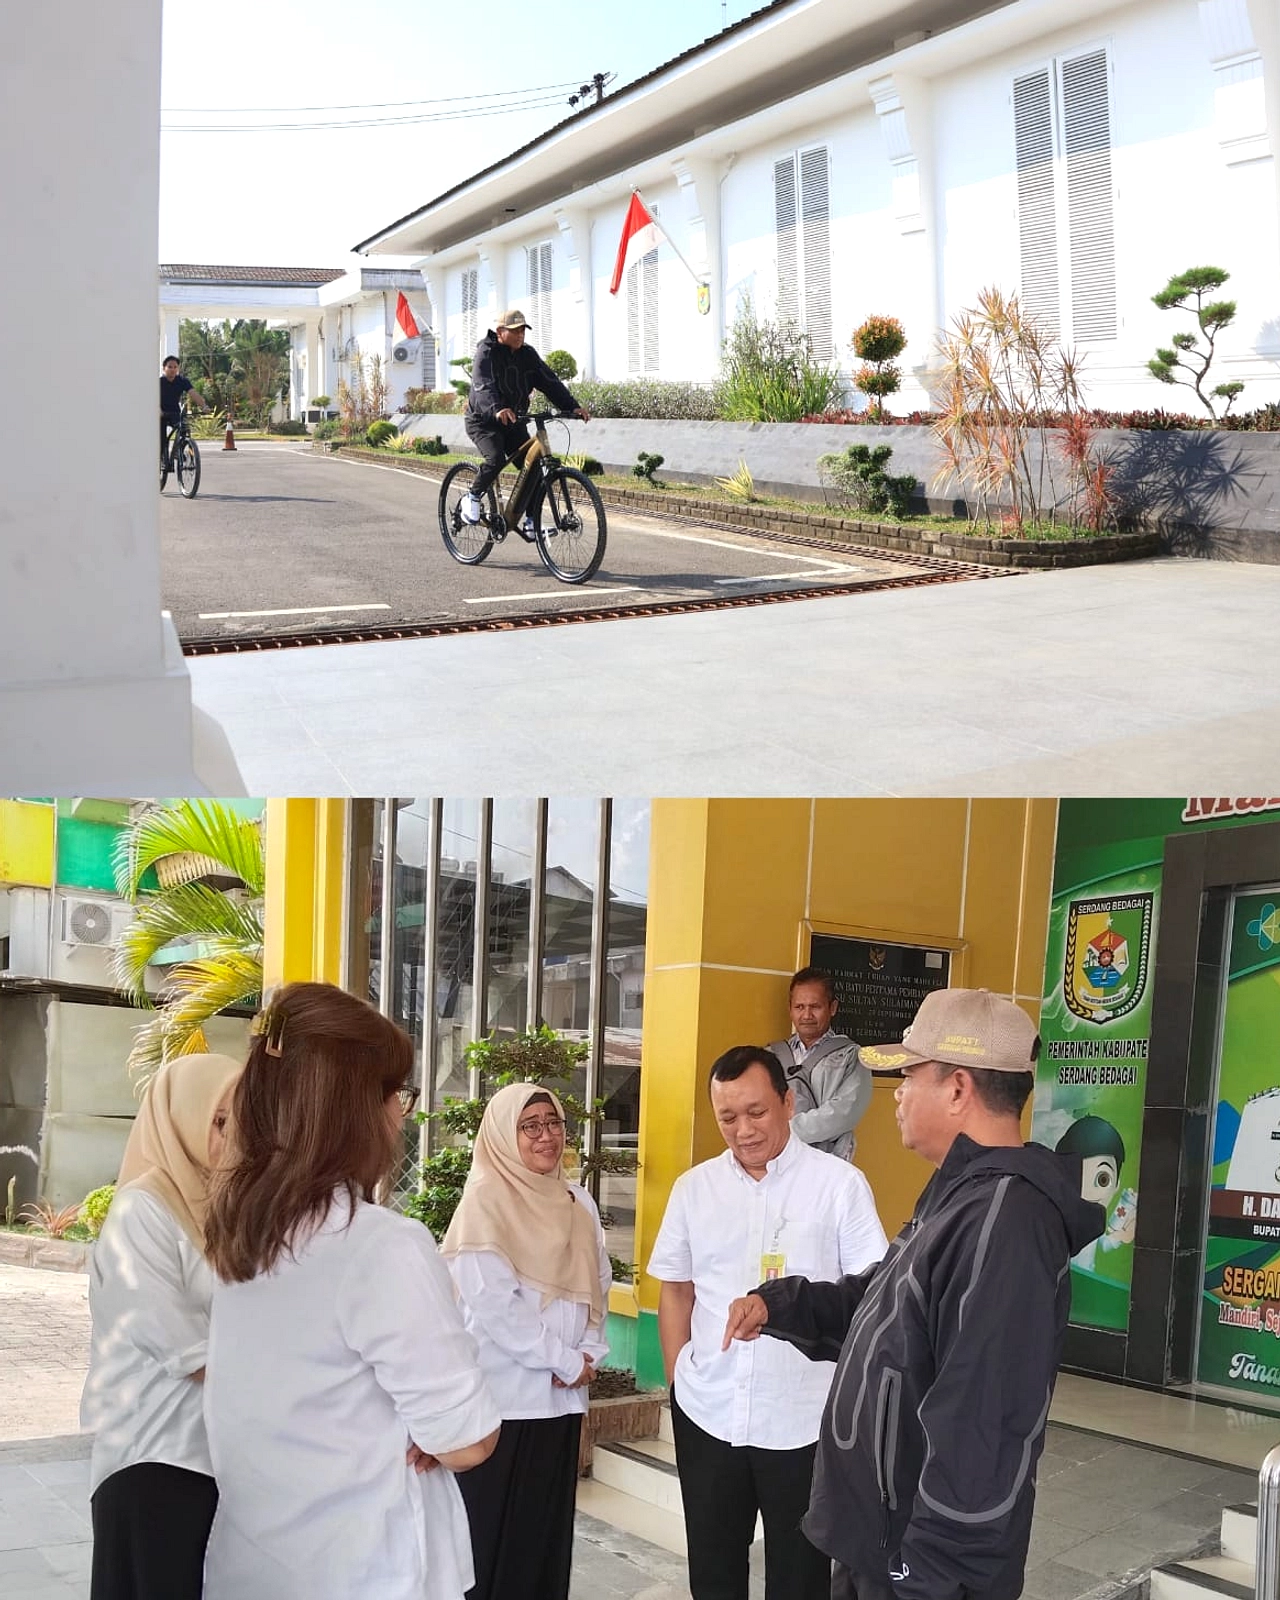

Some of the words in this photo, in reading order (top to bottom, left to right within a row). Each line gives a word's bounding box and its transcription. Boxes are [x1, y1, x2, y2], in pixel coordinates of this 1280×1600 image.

[1078, 902, 1111, 914] SERDANG
[1112, 898, 1144, 911] BEDAGAI
[1048, 1041, 1100, 1059] PEMERINTAH
[1102, 1039, 1149, 1058] KABUPATE
[1059, 1066, 1098, 1085] SERDANG
[1099, 1066, 1137, 1085] BEDAGAI
[1242, 1195, 1257, 1217] H.
